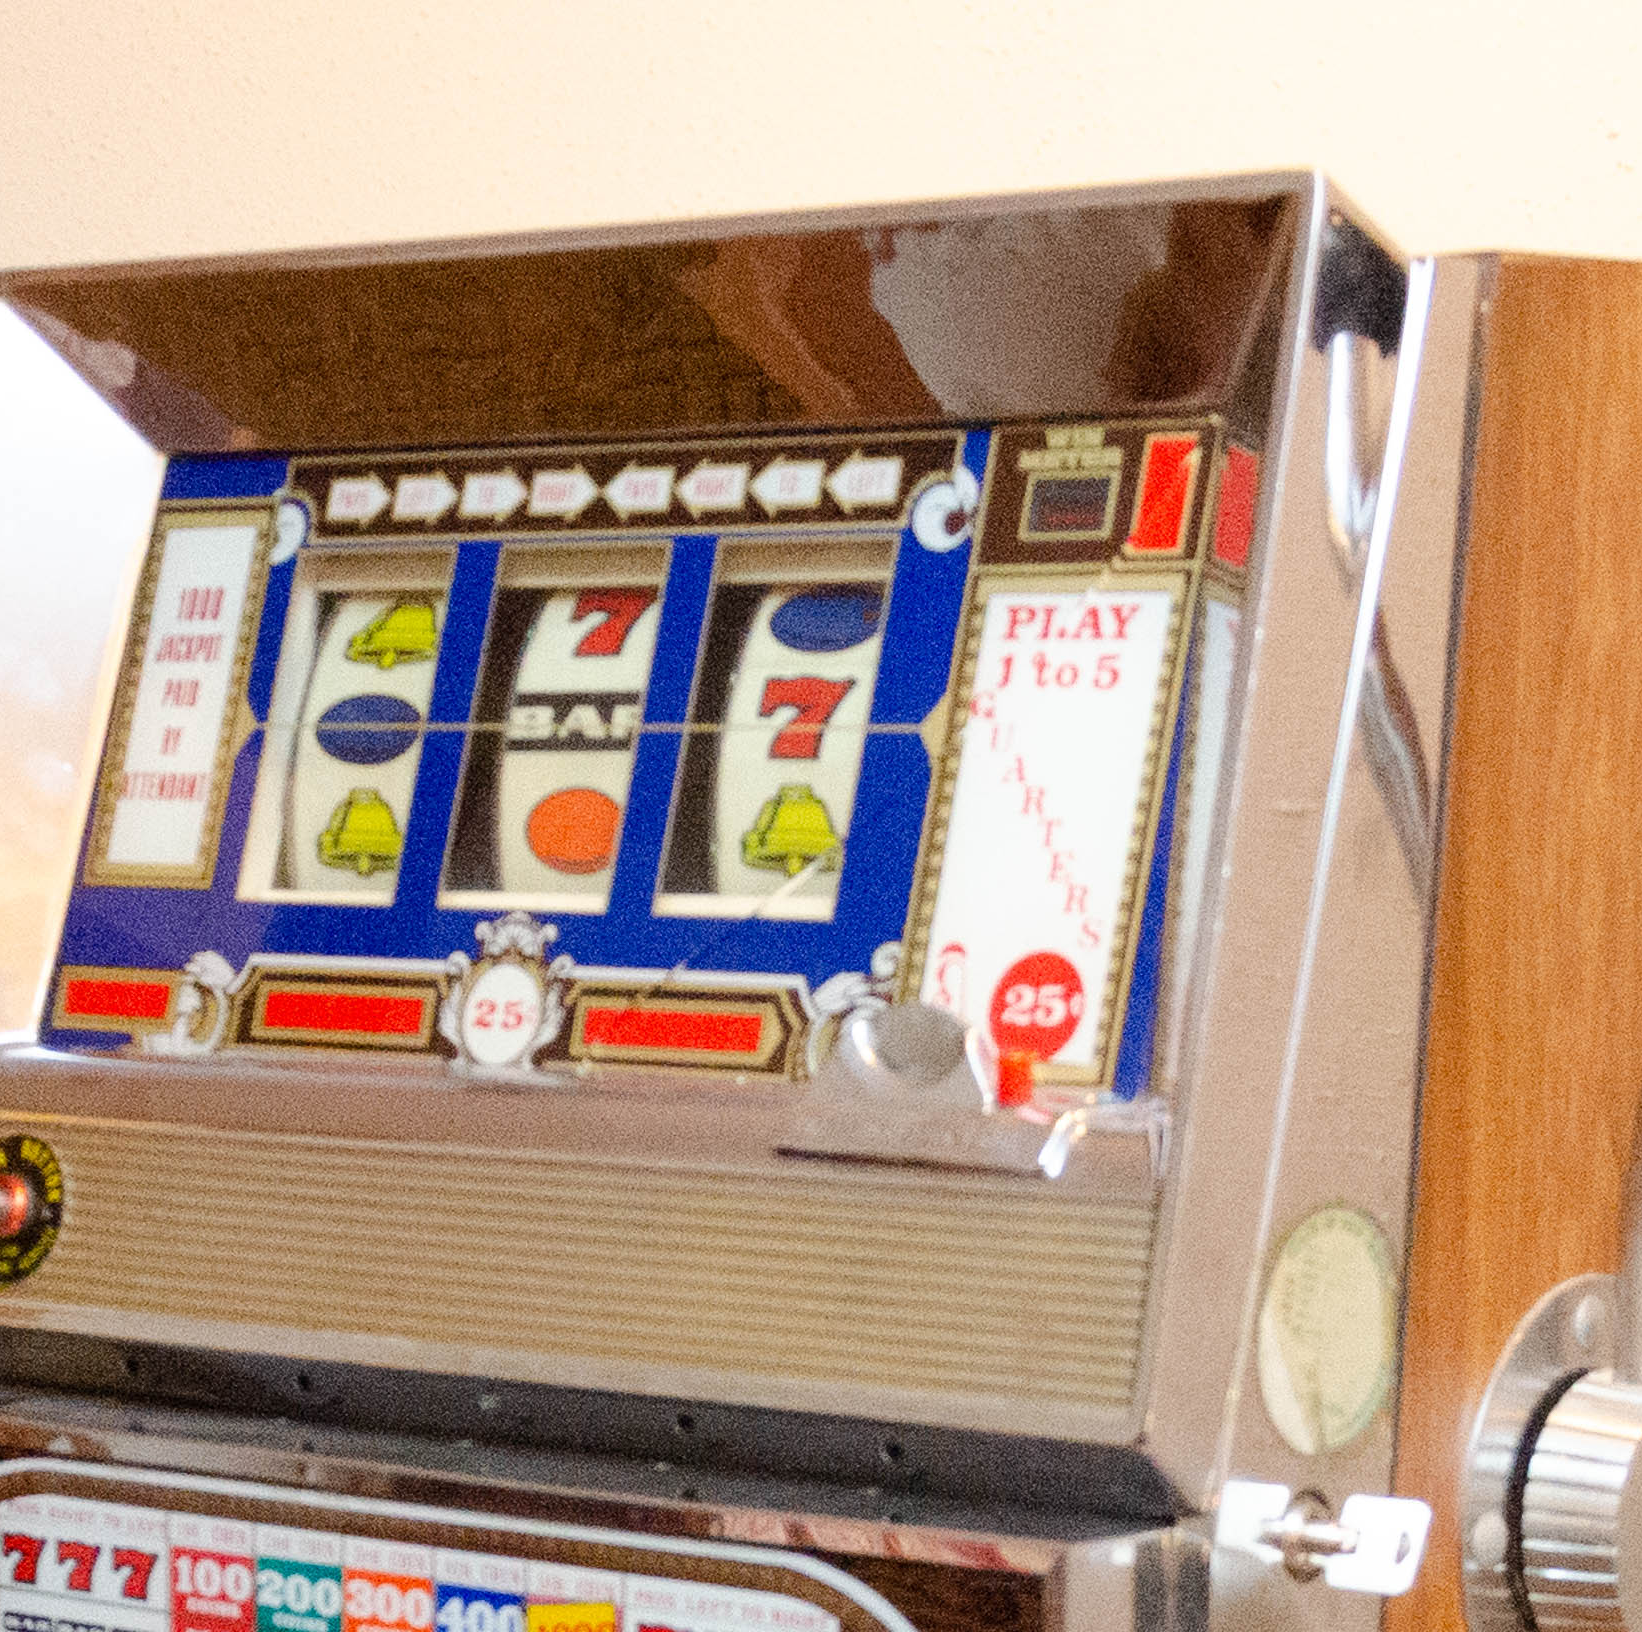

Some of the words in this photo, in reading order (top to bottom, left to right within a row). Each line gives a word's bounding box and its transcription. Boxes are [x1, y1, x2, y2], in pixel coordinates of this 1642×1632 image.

[570, 588, 661, 657] 7
[1003, 603, 1141, 641] PLAY
[155, 632, 223, 664] JACKPOT
[997, 654, 1014, 690] 1
[1033, 651, 1079, 689] to
[1093, 653, 1121, 691] 5
[162, 678, 201, 708] PAID
[759, 676, 857, 759] 7
[176, 1555, 253, 1600] 100
[257, 1569, 342, 1618] 200
[345, 1579, 432, 1629] 300
